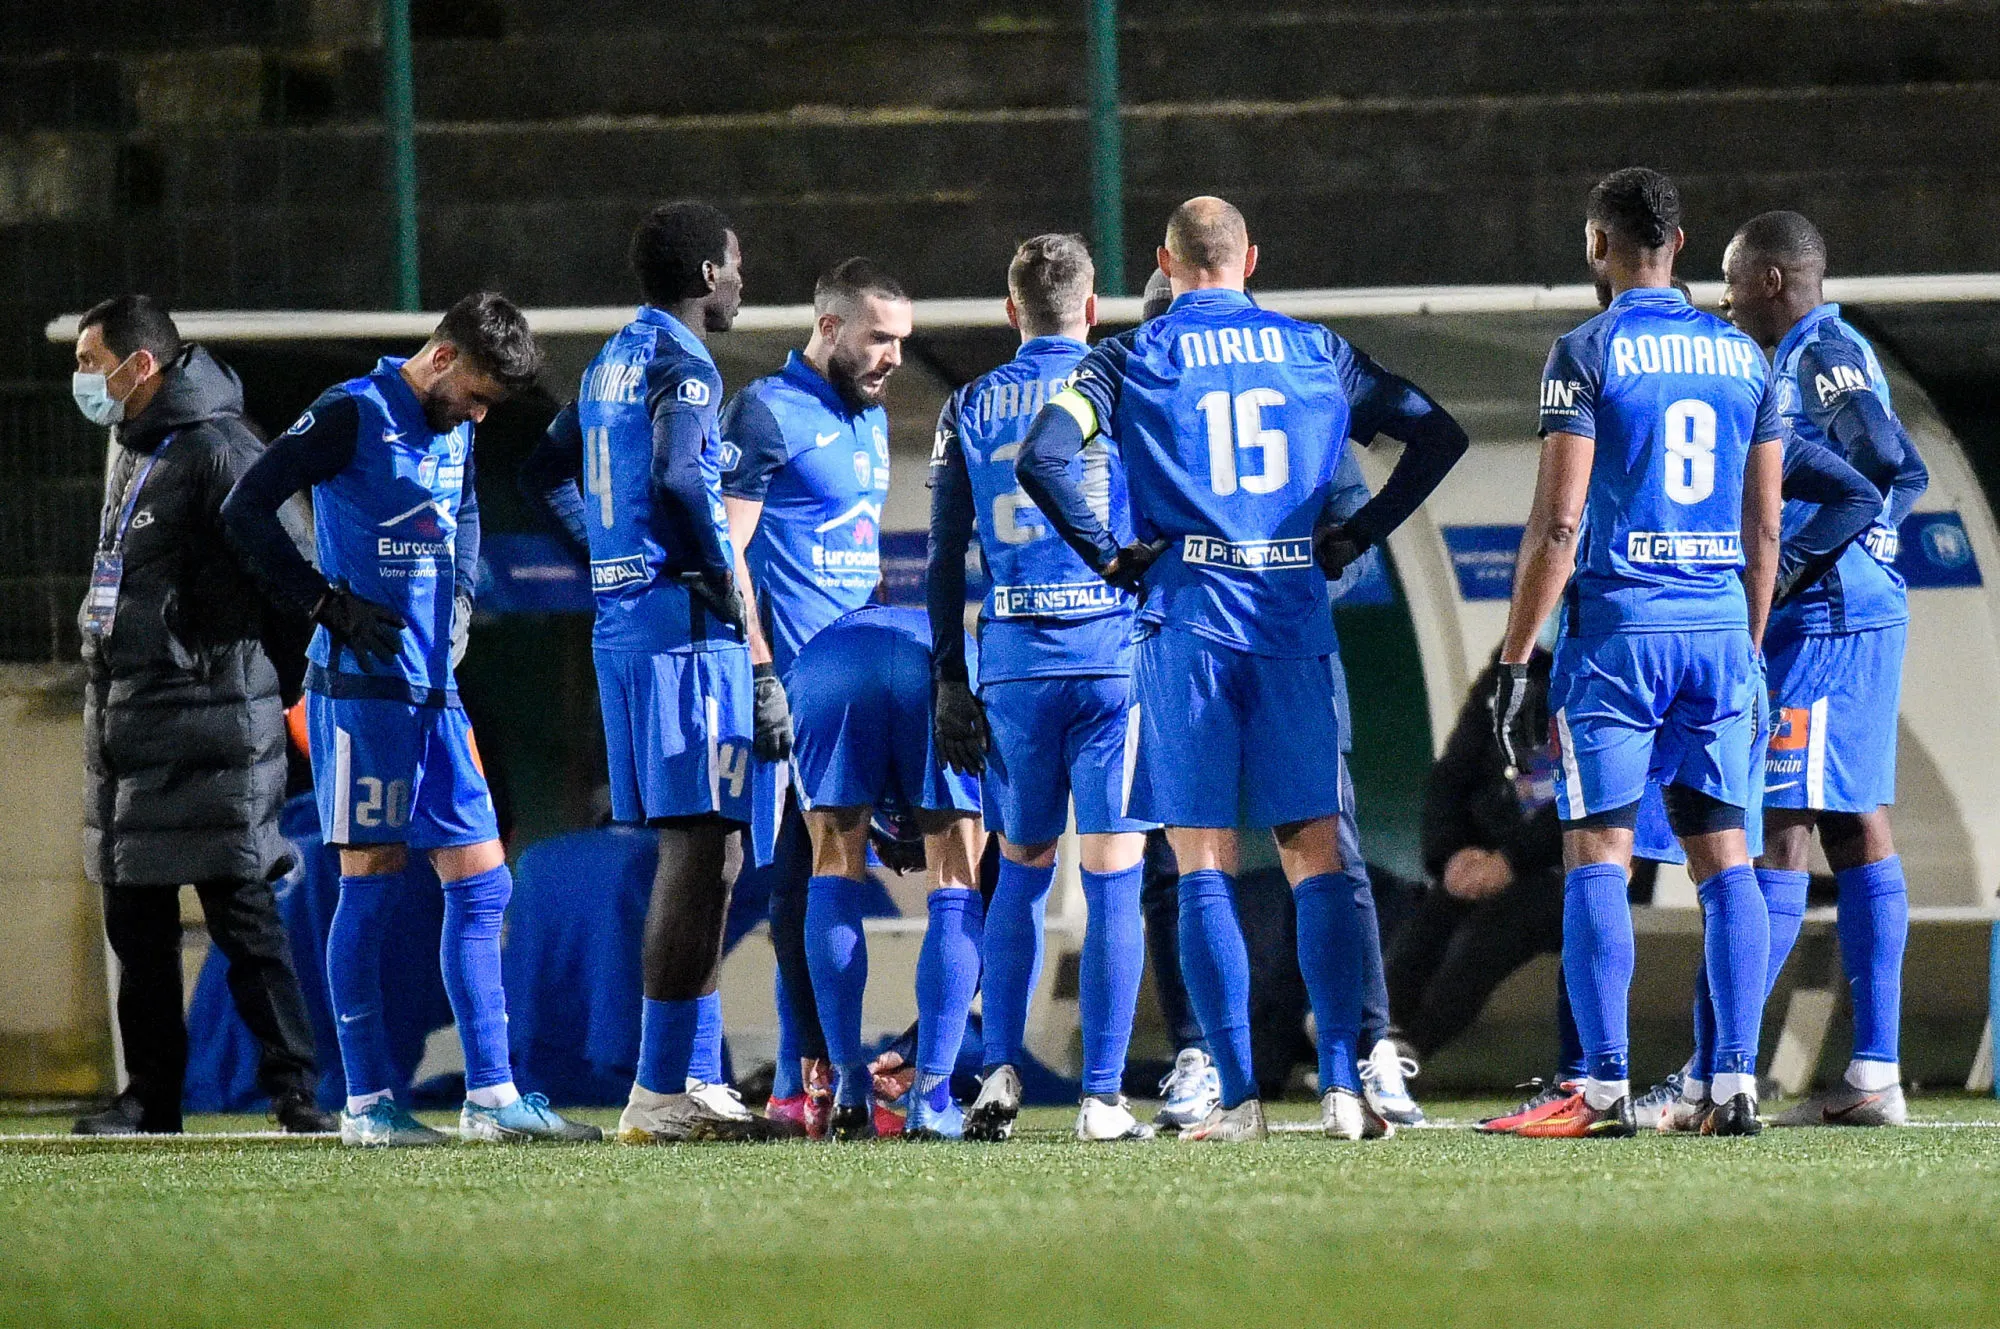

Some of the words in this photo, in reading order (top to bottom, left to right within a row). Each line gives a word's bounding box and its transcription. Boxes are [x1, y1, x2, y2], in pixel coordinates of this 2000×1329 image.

[1180, 327, 1285, 368] NIRLO
[1613, 334, 1753, 379] ROMANY
[1815, 365, 1865, 403] AIN
[1196, 388, 1290, 496] 15
[1665, 399, 1716, 505] 8
[587, 425, 614, 529] 4
[719, 743, 748, 797] 4
[356, 776, 409, 828] 20
